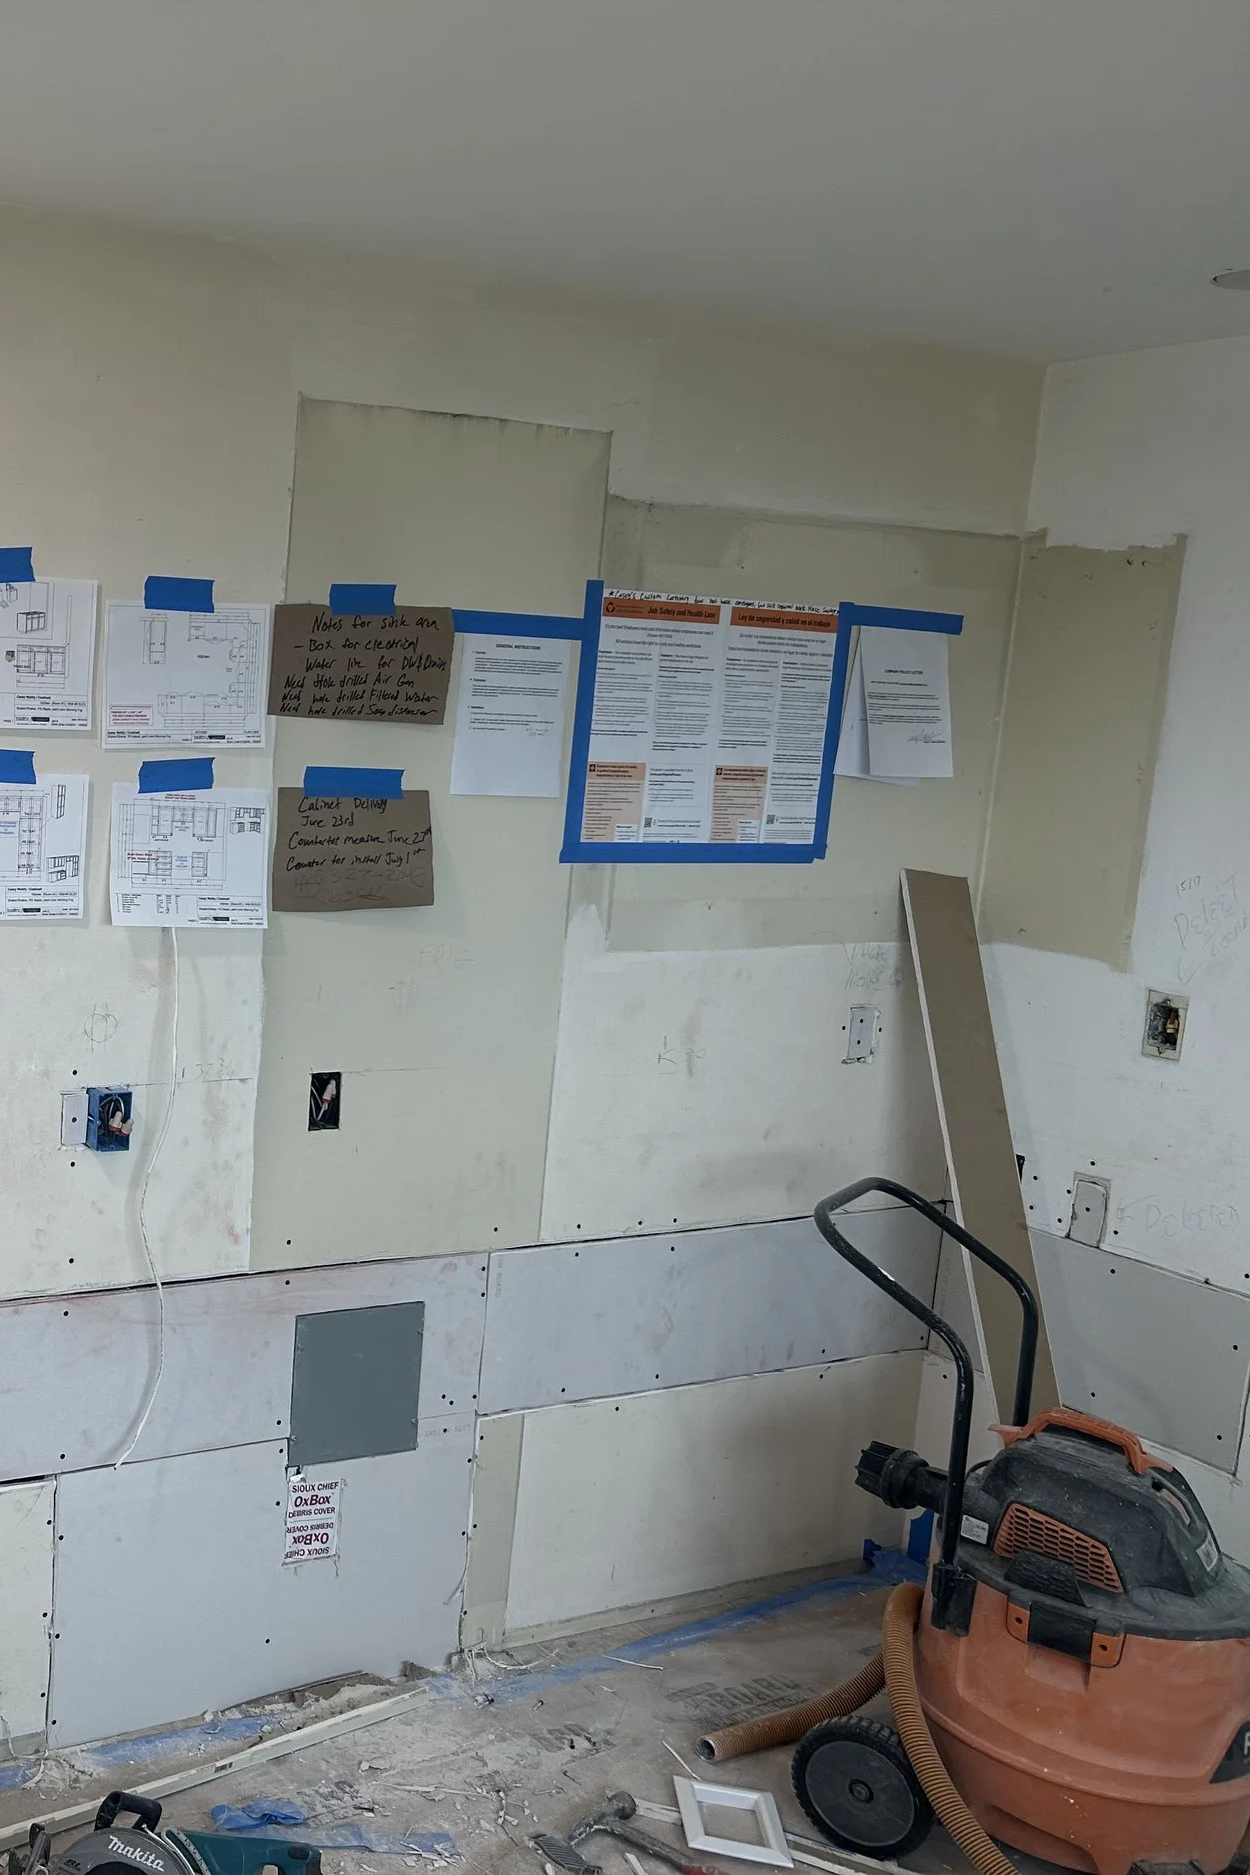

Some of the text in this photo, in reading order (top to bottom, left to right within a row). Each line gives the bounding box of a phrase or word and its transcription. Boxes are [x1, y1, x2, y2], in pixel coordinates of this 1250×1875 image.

[647, 606, 658, 615] Job
[659, 607, 675, 617] Safety
[686, 608, 703, 617] Health
[704, 610, 716, 618] Law
[311, 611, 344, 634] Notes
[352, 614, 372, 629] for
[380, 613, 410, 630] sink
[737, 612, 747, 621] Ley
[755, 615, 781, 624] seguridad
[785, 616, 800, 625] salud
[813, 619, 831, 628] trabajo
[309, 636, 419, 653] Box for electrical
[305, 656, 337, 673] Water
[377, 655, 394, 670] for
[284, 673, 306, 690] Need
[339, 672, 368, 689] drilled
[372, 672, 393, 687] Air
[281, 689, 301, 703] Need
[336, 689, 366, 703] drilled
[369, 688, 399, 702] Filtered
[404, 692, 439, 703] Water
[279, 702, 301, 714] Need
[331, 702, 363, 717] drilled
[300, 812, 355, 828] June 23rd
[387, 829, 412, 846] June
[291, 1481, 339, 1494] SIOUX CHIEF
[294, 1494, 332, 1508] OxBox
[288, 1506, 336, 1518] DEBRIS COVER
[286, 1522, 334, 1534] DEBRIS COVER
[292, 1532, 329, 1546] OxBox
[307, 1546, 330, 1556] SIOUX
